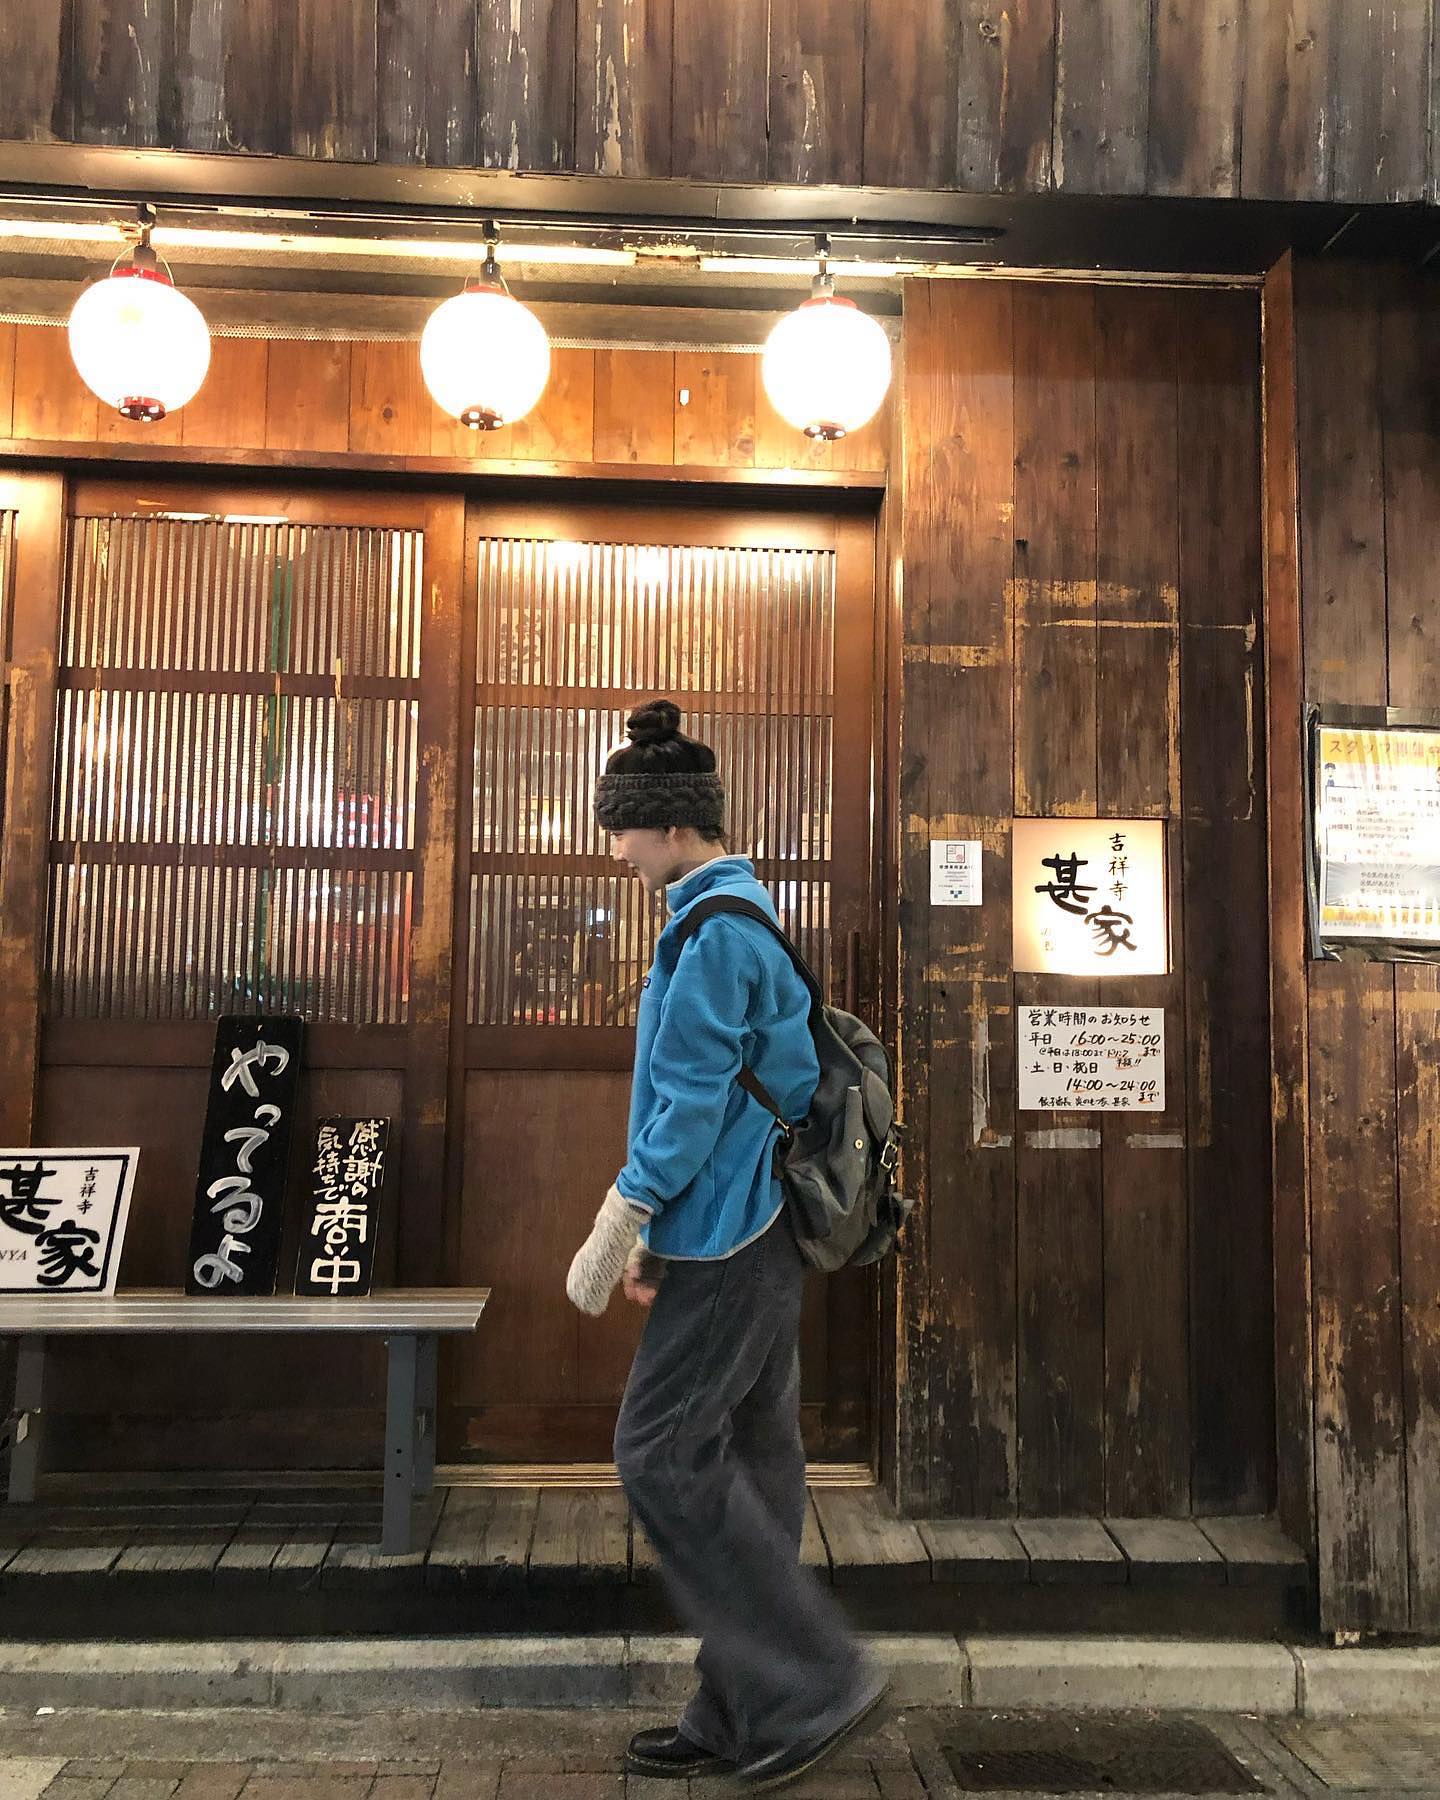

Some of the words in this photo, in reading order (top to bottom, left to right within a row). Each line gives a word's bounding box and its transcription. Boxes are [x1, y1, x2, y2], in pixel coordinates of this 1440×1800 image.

[1109, 832, 1129, 902] 吉祥寺
[1028, 1008, 1151, 1027] 営業時間のお知らせ
[77, 1166, 99, 1215] 吉祥寺
[193, 1039, 291, 1289] やってるよ
[312, 1126, 349, 1201] 気持ちで
[343, 1119, 385, 1199] 感謝の
[310, 1196, 369, 1295] 商い中
